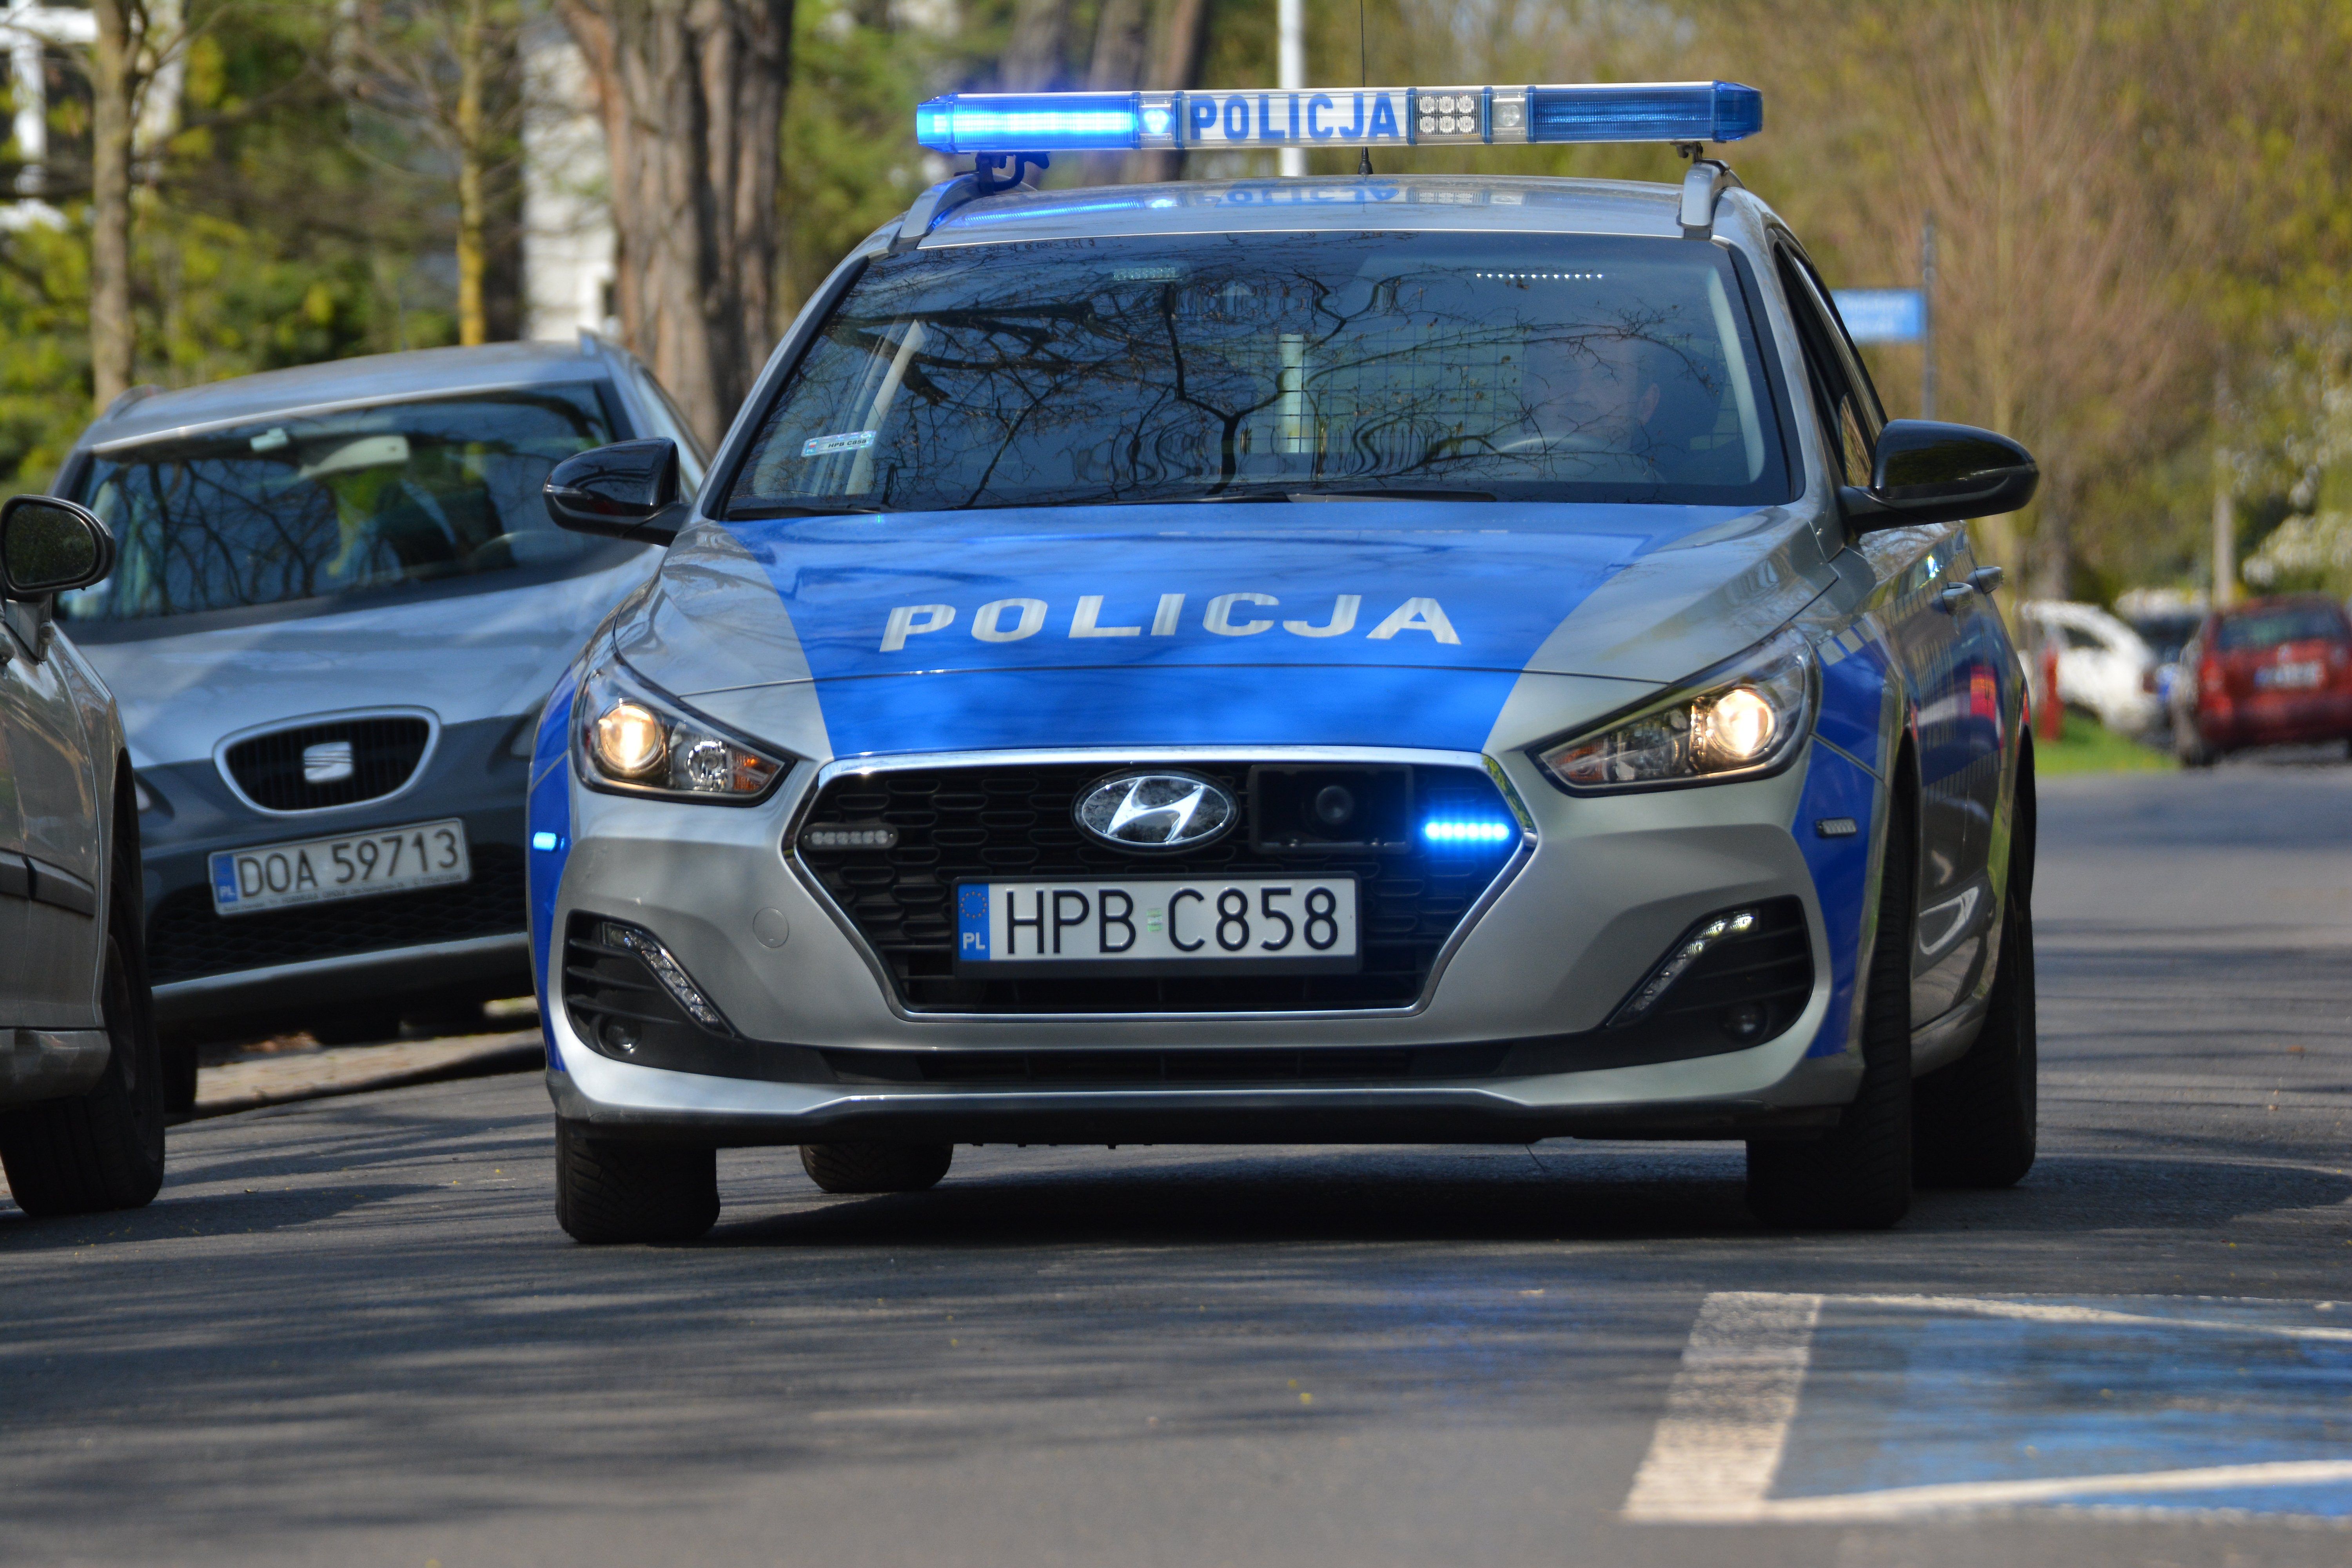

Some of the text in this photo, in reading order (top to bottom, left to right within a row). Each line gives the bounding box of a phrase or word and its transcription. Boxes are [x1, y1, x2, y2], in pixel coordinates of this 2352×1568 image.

[1191, 93, 1399, 142] POLICJA
[879, 592, 1461, 652] POLICJA
[237, 828, 457, 898] DOA 59713
[962, 932, 985, 950] PL
[1006, 887, 1338, 954] HPB C858
